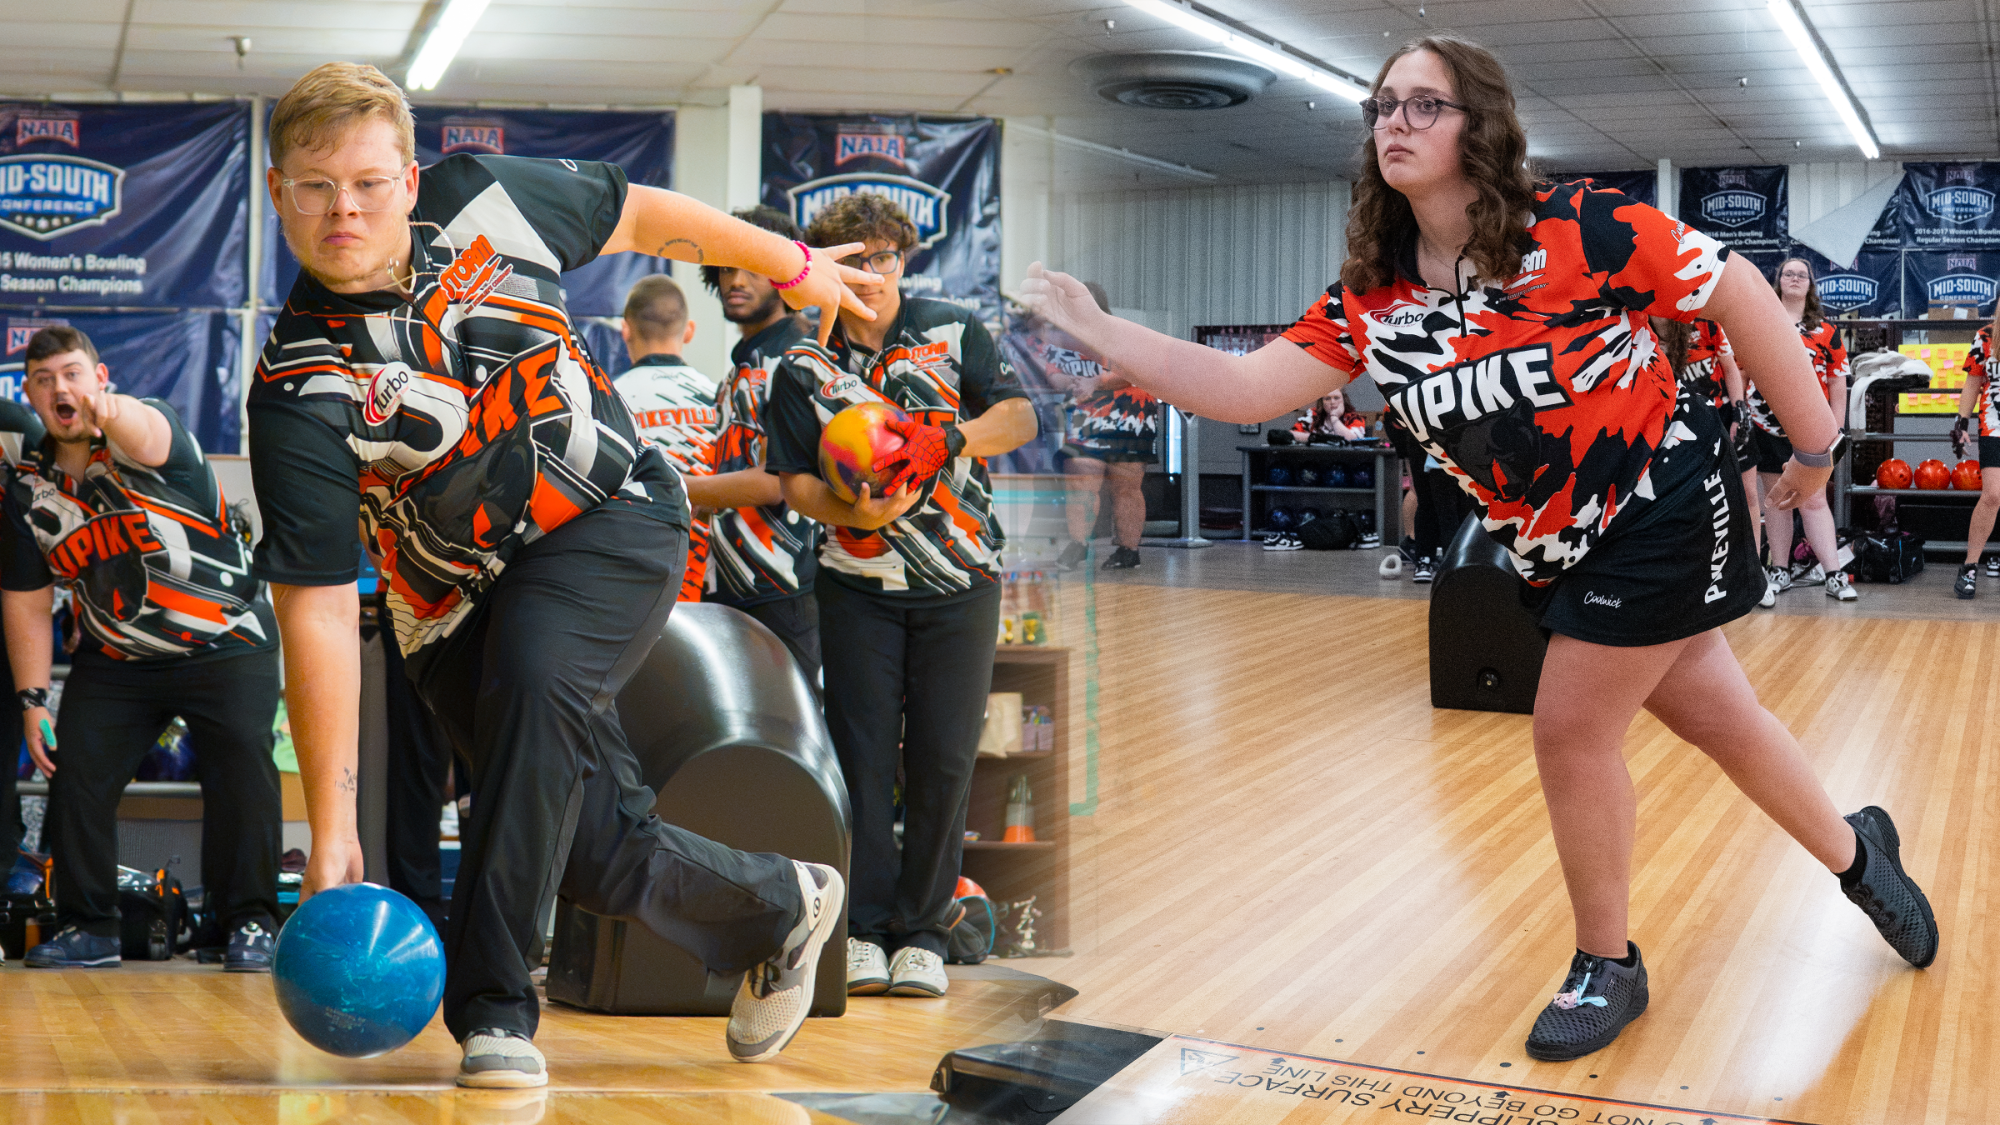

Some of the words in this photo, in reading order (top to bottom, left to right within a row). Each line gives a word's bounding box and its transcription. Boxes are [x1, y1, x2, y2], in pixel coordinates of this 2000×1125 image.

[20, 121, 77, 142] NAIA
[447, 128, 500, 147] NAIA
[841, 136, 900, 158] NAIA
[0, 163, 109, 205] ID-SOUTH
[0, 199, 95, 211] ONFERENCE
[1707, 195, 1760, 213] MID-SOUTH
[1932, 191, 1989, 209] MID-SOUTH
[1738, 230, 1763, 238] Bowling
[1966, 236, 2000, 245] Champion
[14, 252, 83, 270] Women's
[85, 254, 147, 274] Bowling
[440, 235, 496, 299] STORM
[1949, 258, 1975, 269] NAIA
[0, 273, 57, 292] Season
[58, 275, 143, 296] Champions
[1817, 278, 1873, 297] MID-SOUTH
[1934, 278, 1991, 297] MID-SOUTH
[1382, 311, 1424, 325] Turbo
[911, 340, 949, 360] STORM
[373, 369, 409, 413] Turbo
[830, 379, 858, 394] Turbo
[1390, 347, 1567, 443] UPIKE
[50, 512, 163, 580] UPIKE
[1262, 1063, 1327, 1083] LINE
[1214, 1070, 1377, 1106] SURFACE
[1331, 1074, 1394, 1094] THIS
[1402, 1085, 1527, 1112] BEYOND
[1533, 1105, 1580, 1120] GO
